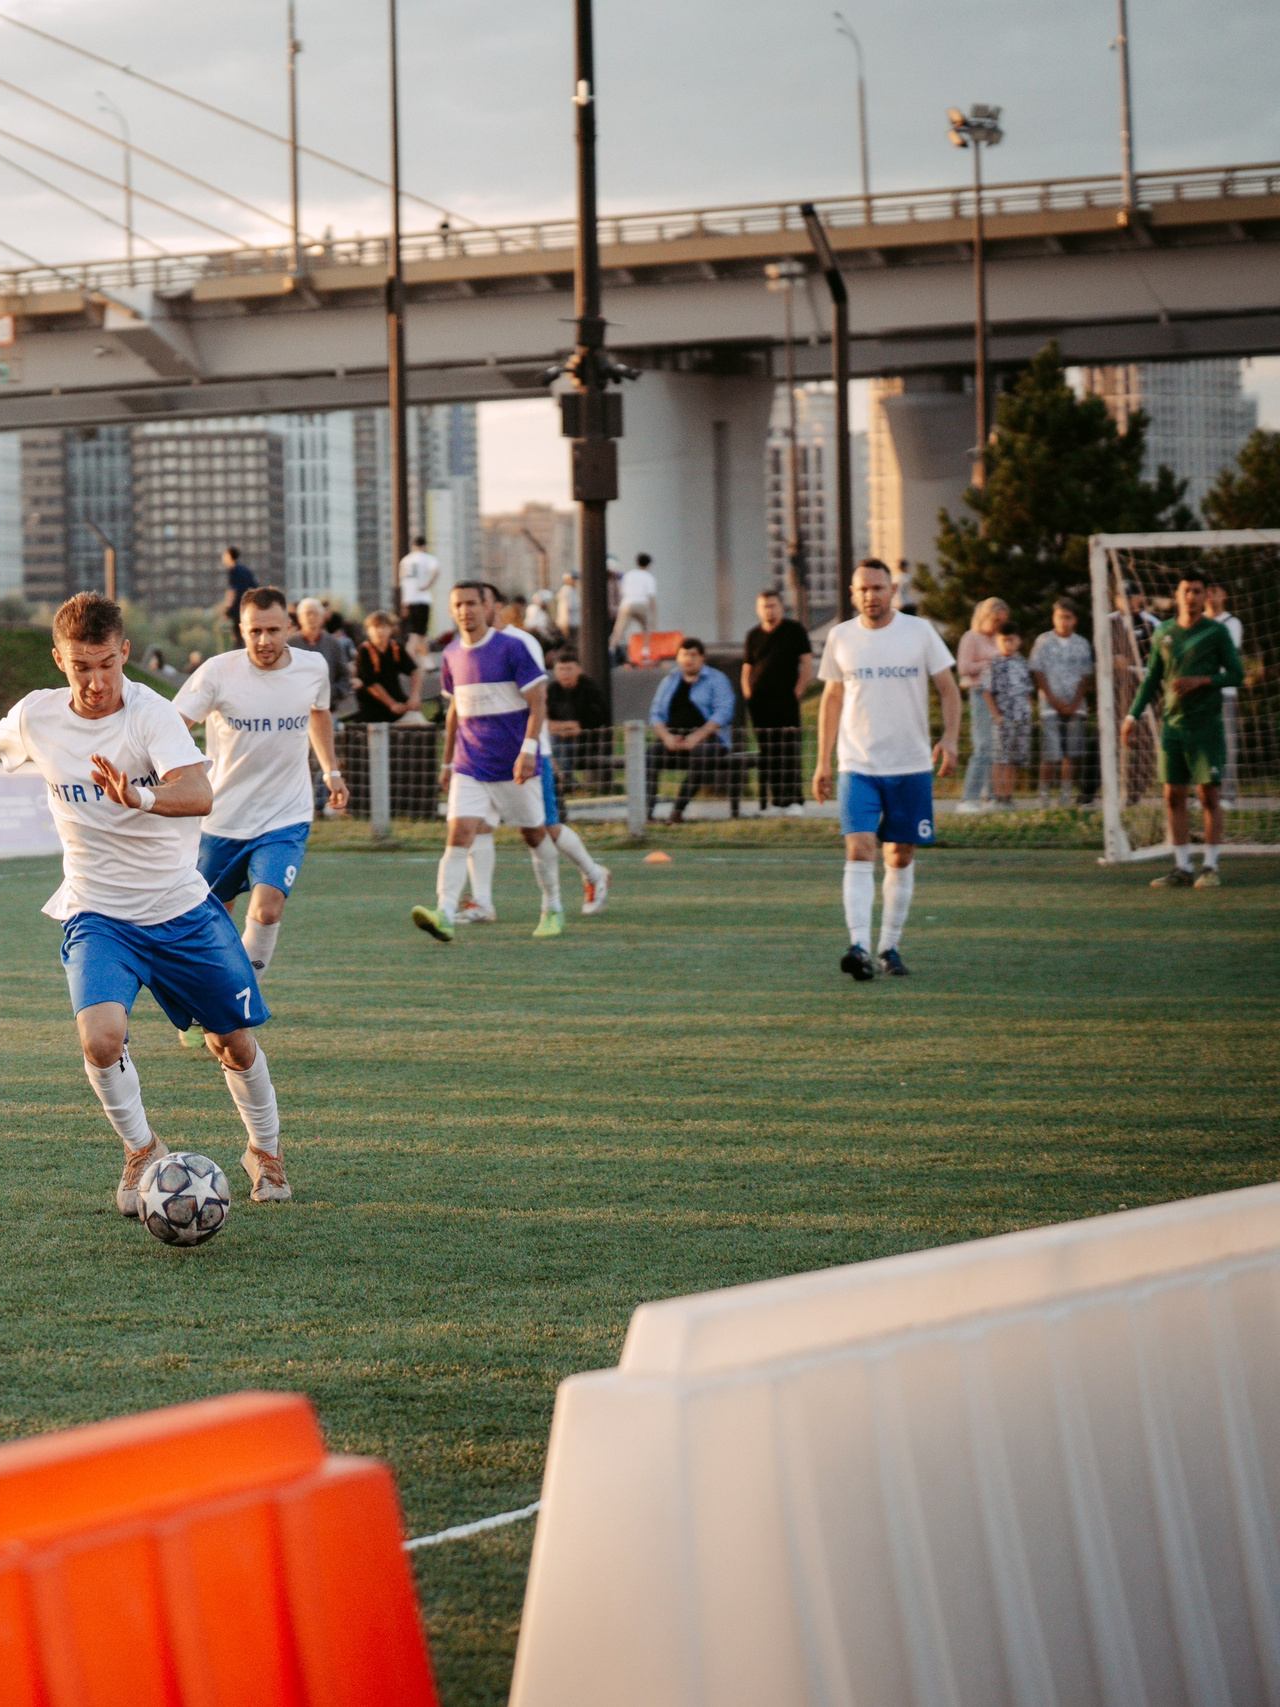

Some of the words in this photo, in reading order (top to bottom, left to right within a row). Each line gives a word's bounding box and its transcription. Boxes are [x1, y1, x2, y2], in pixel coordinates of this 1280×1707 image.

[227, 717, 272, 732] ПОЧТА
[278, 715, 308, 731] РОСС
[918, 818, 932, 838] 6
[284, 865, 297, 887] 9
[235, 986, 251, 1020] 7
